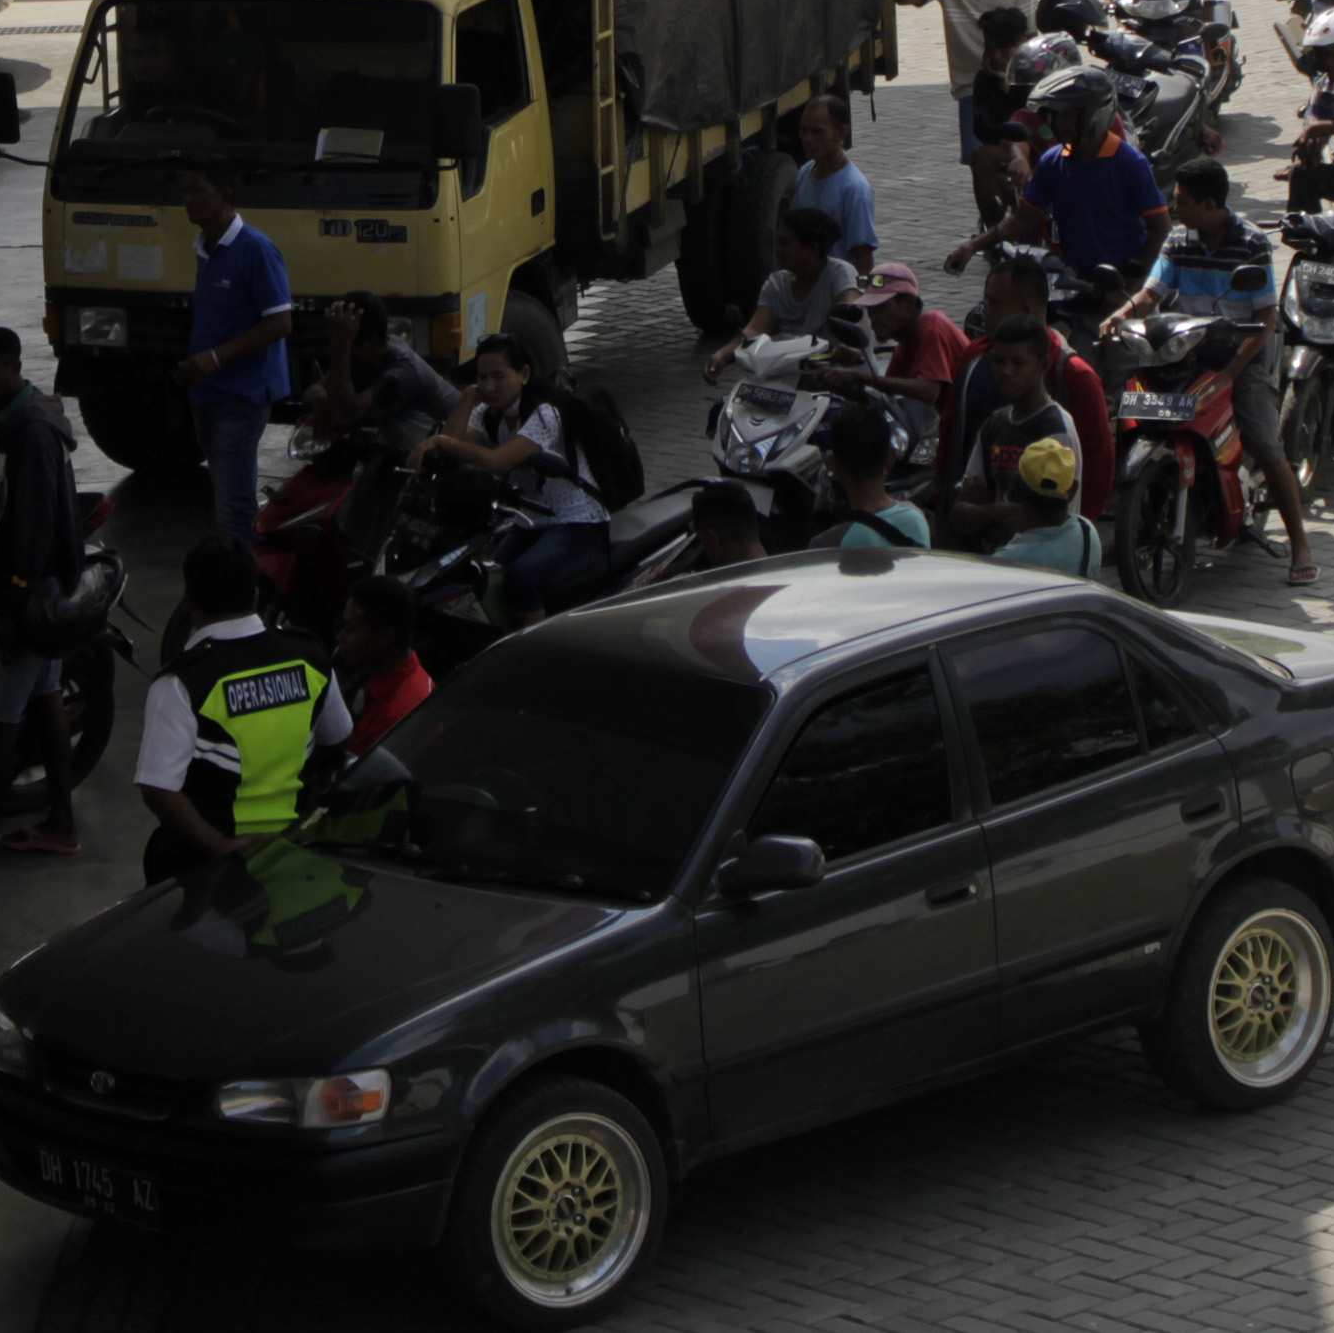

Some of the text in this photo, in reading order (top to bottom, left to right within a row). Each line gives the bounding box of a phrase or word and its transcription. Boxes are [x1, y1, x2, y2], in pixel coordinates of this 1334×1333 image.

[1122, 394, 1138, 406] DH
[1178, 396, 1196, 408] AK
[227, 670, 307, 713] OPERASIONAL
[39, 1149, 156, 1212] DH 1745 AZ
